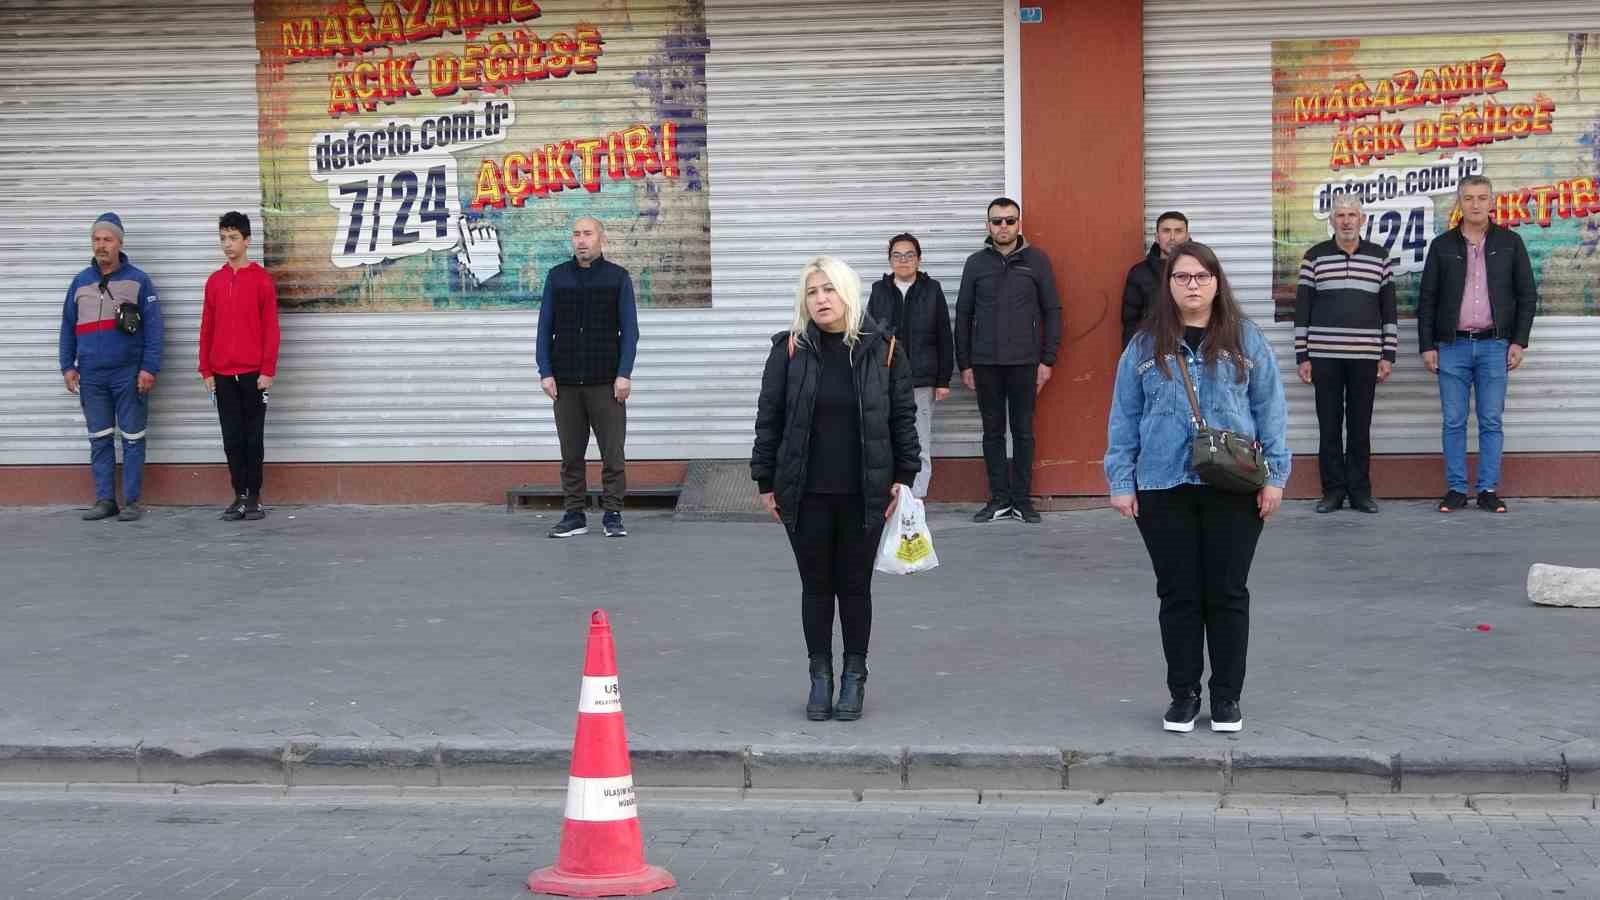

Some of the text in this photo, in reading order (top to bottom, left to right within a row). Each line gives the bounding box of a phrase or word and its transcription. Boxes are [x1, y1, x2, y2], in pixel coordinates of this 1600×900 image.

[1293, 52, 1507, 127] MAĞAZAMIZ
[316, 101, 509, 172] defacto.com.tr
[470, 120, 679, 209] AÇIKTIR!
[339, 165, 450, 255] 7/24
